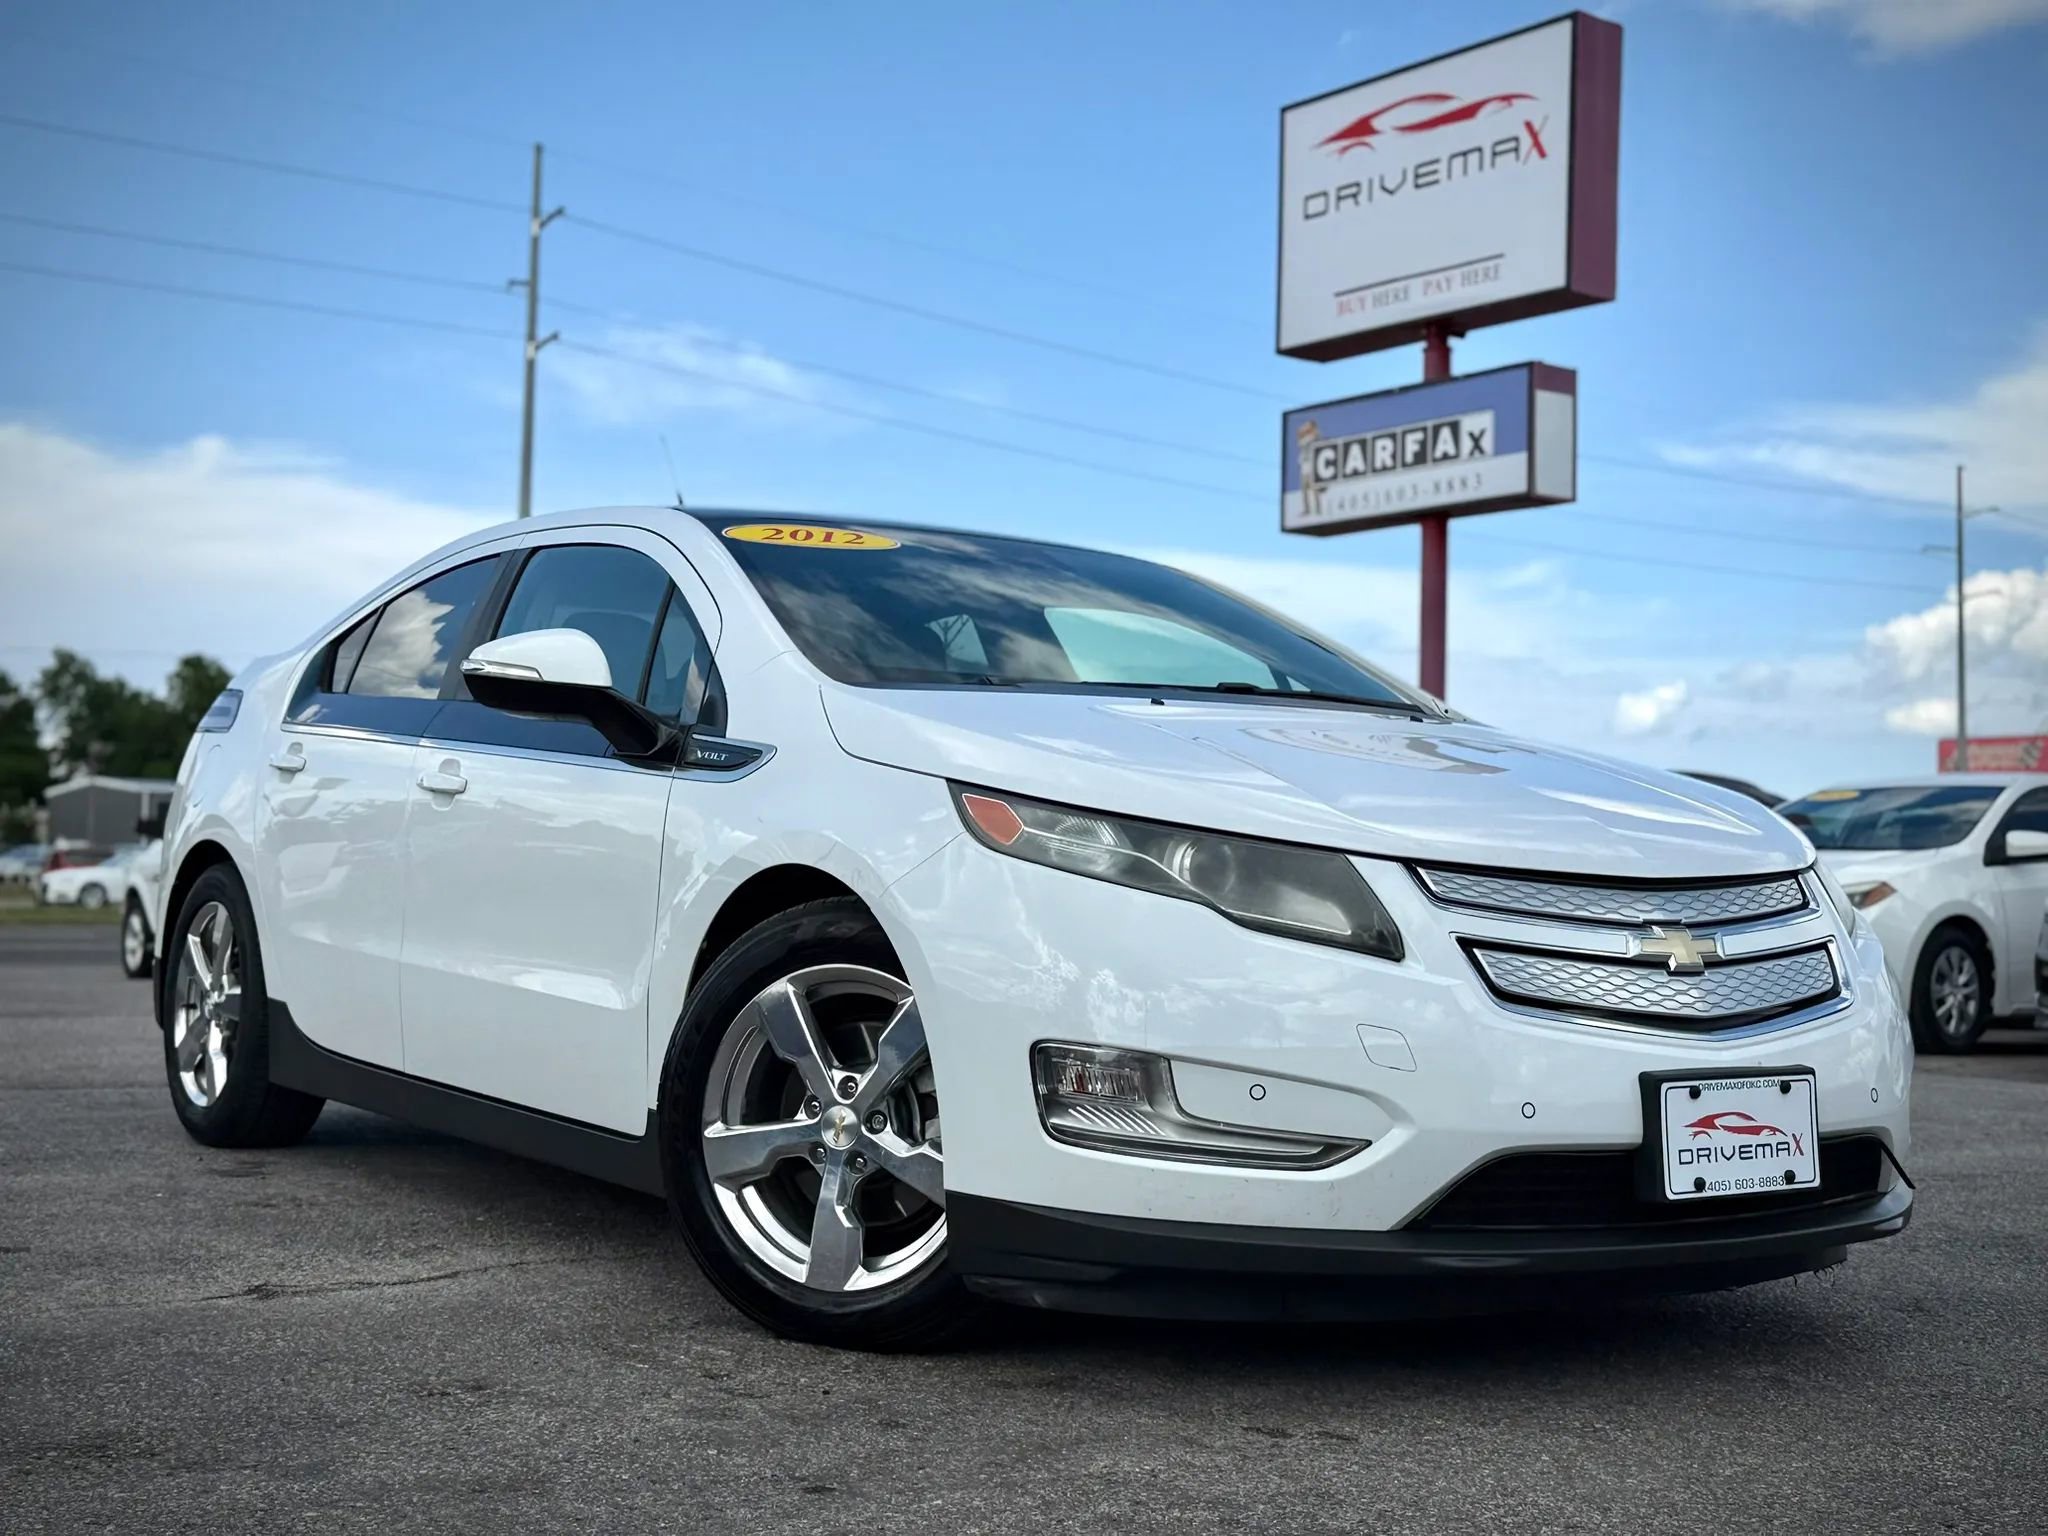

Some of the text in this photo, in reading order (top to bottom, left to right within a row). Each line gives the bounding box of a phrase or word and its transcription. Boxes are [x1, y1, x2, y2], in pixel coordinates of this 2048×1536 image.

[1302, 114, 1549, 221] DRIVEMAX
[1336, 262, 1501, 317] BUY HERE PAY HERE
[1314, 425, 1489, 482] CARFAX
[760, 527, 866, 545] 2012
[696, 748, 729, 761] VOLT
[1678, 1132, 1805, 1166] DRIVEMAX
[1734, 1175, 1785, 1191] 603-8883
